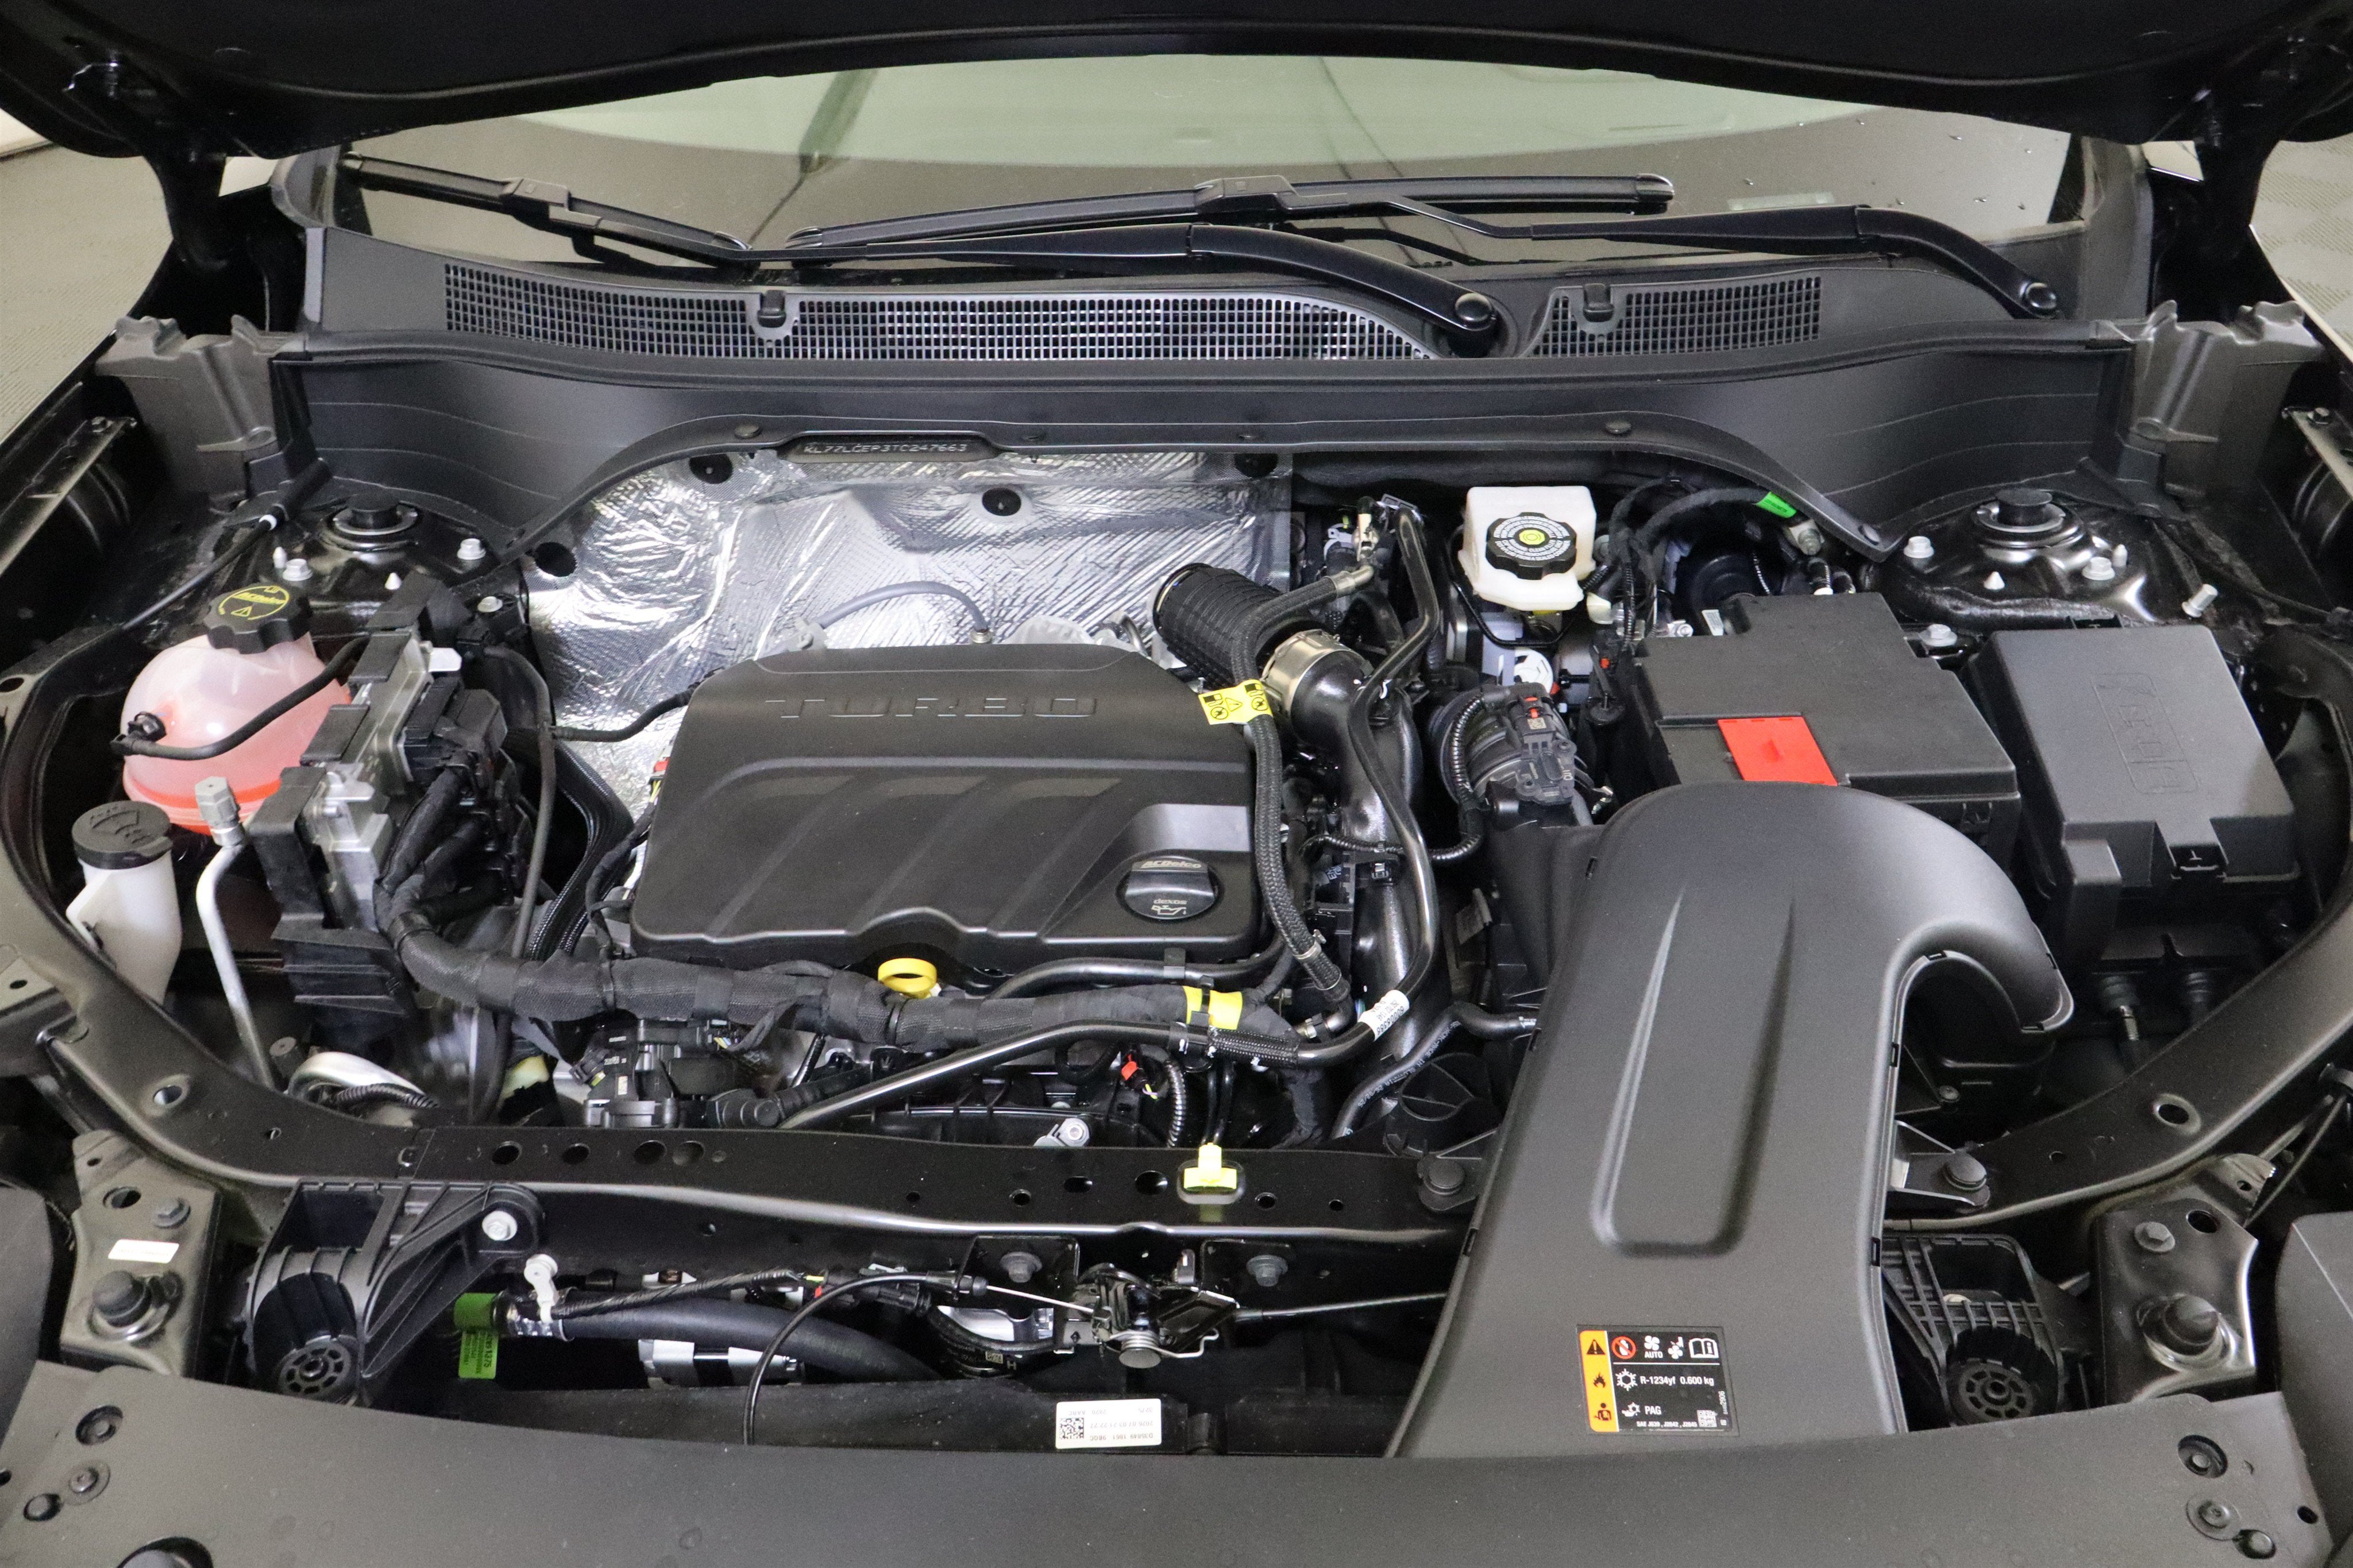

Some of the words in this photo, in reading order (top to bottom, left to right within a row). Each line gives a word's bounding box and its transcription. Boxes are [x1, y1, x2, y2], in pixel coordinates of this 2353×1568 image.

[765, 697, 1098, 719] TURBO
[1140, 860, 1202, 869] ACDelco
[1645, 1351, 1663, 1359] AUTO
[1640, 1376, 1676, 1386] R-1234yf
[1680, 1376, 1702, 1385] 0.600
[1704, 1376, 1715, 1387] kg
[1645, 1405, 1662, 1415] PAG
